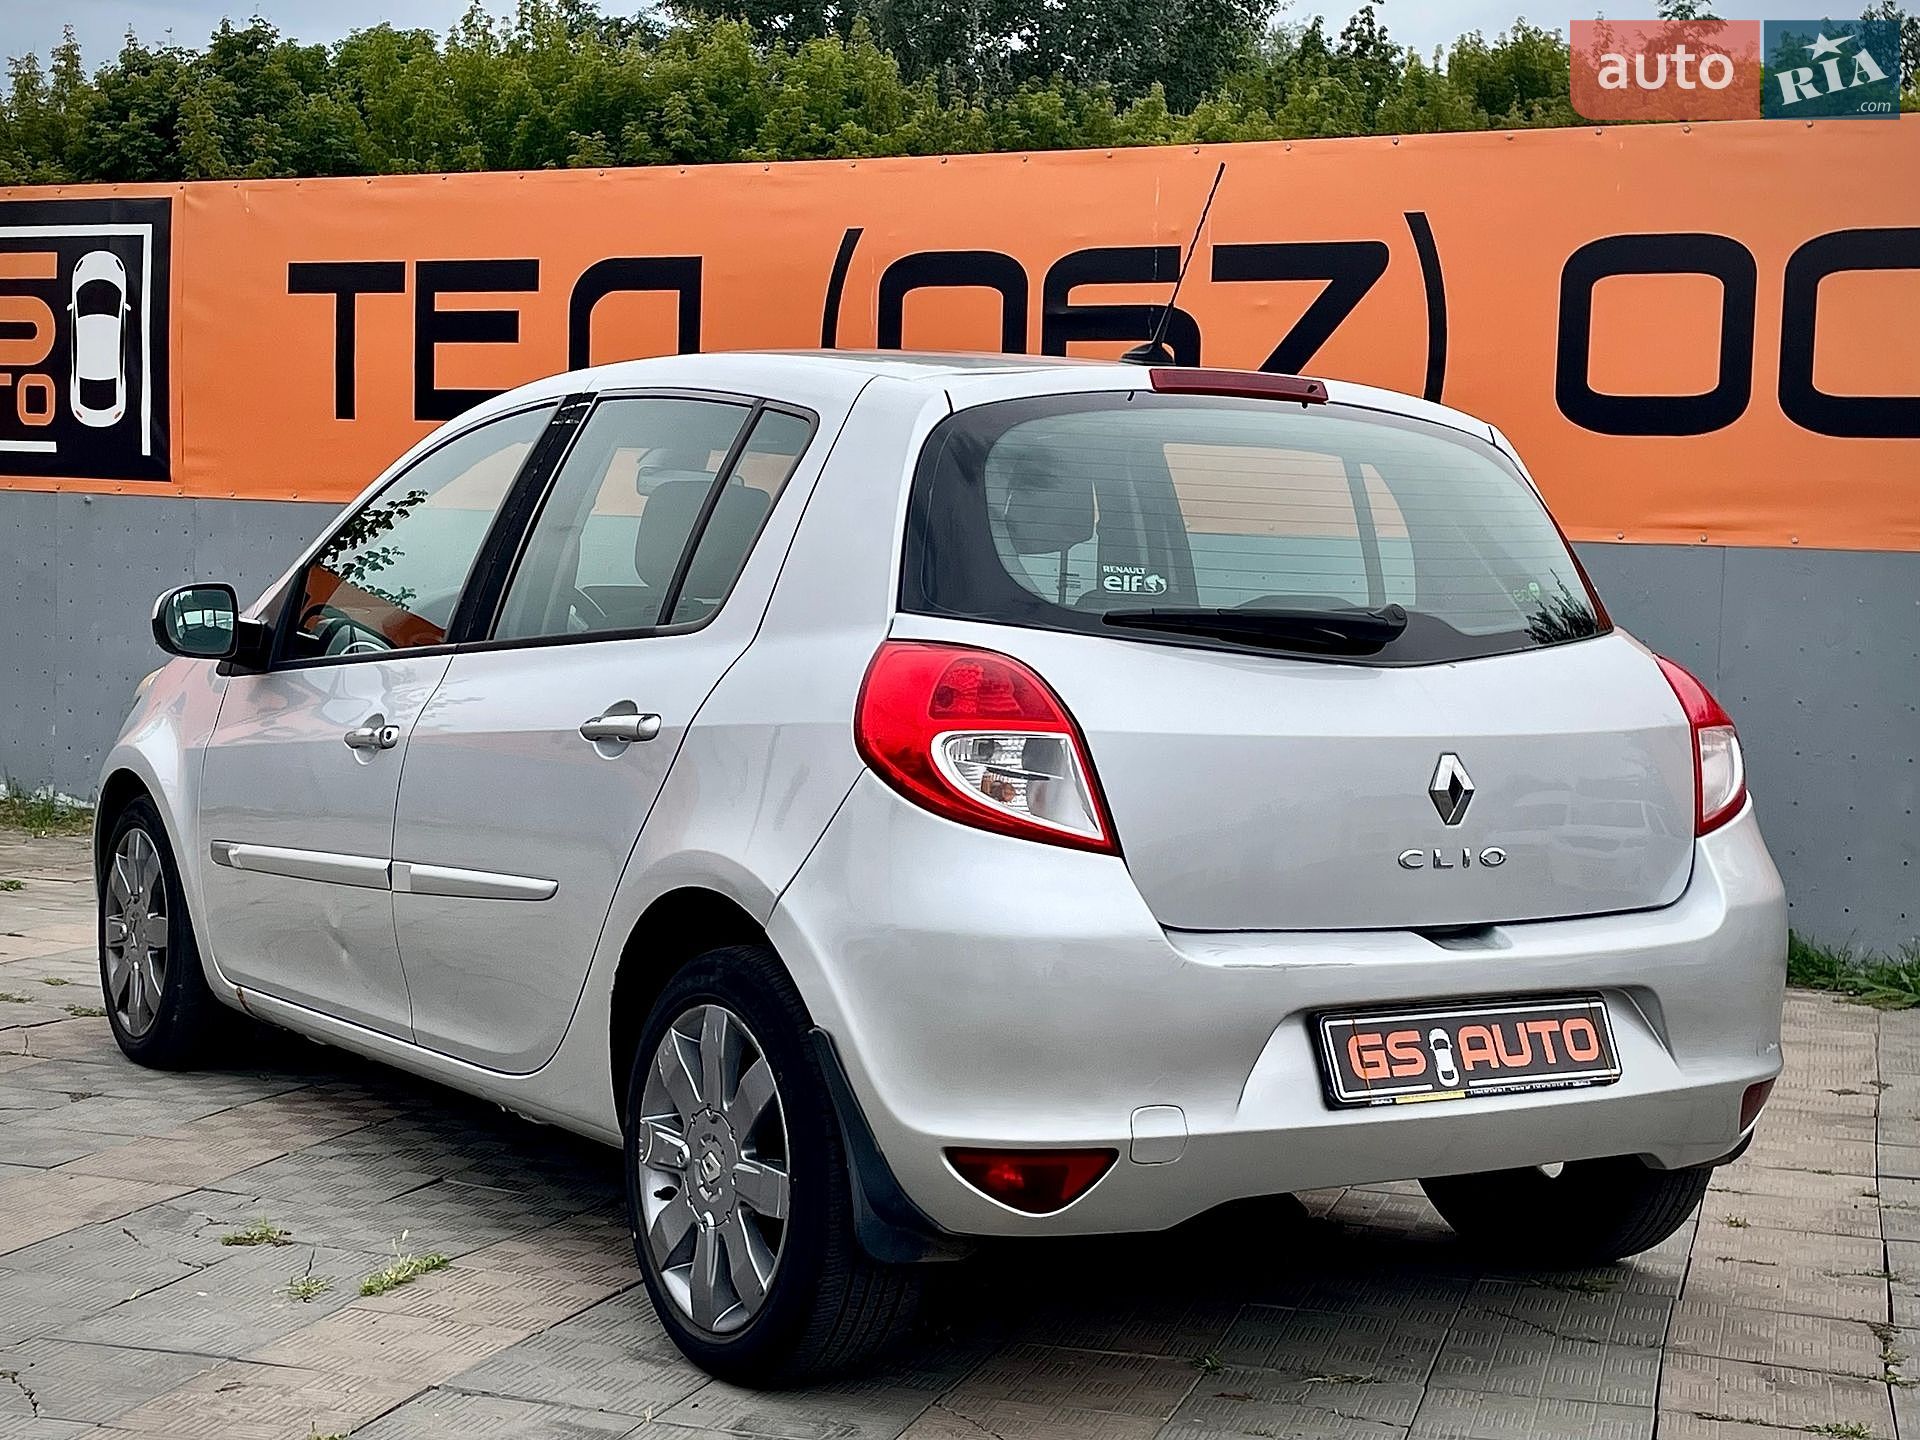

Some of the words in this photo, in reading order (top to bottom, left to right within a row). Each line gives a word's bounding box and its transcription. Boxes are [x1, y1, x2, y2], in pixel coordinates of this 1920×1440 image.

[1102, 565, 1146, 575] RENAULT
[1103, 575, 1143, 592] elf
[1398, 847, 1507, 870] CLIO
[1347, 1030, 1427, 1080] GS
[1457, 1017, 1601, 1071] AUTO
